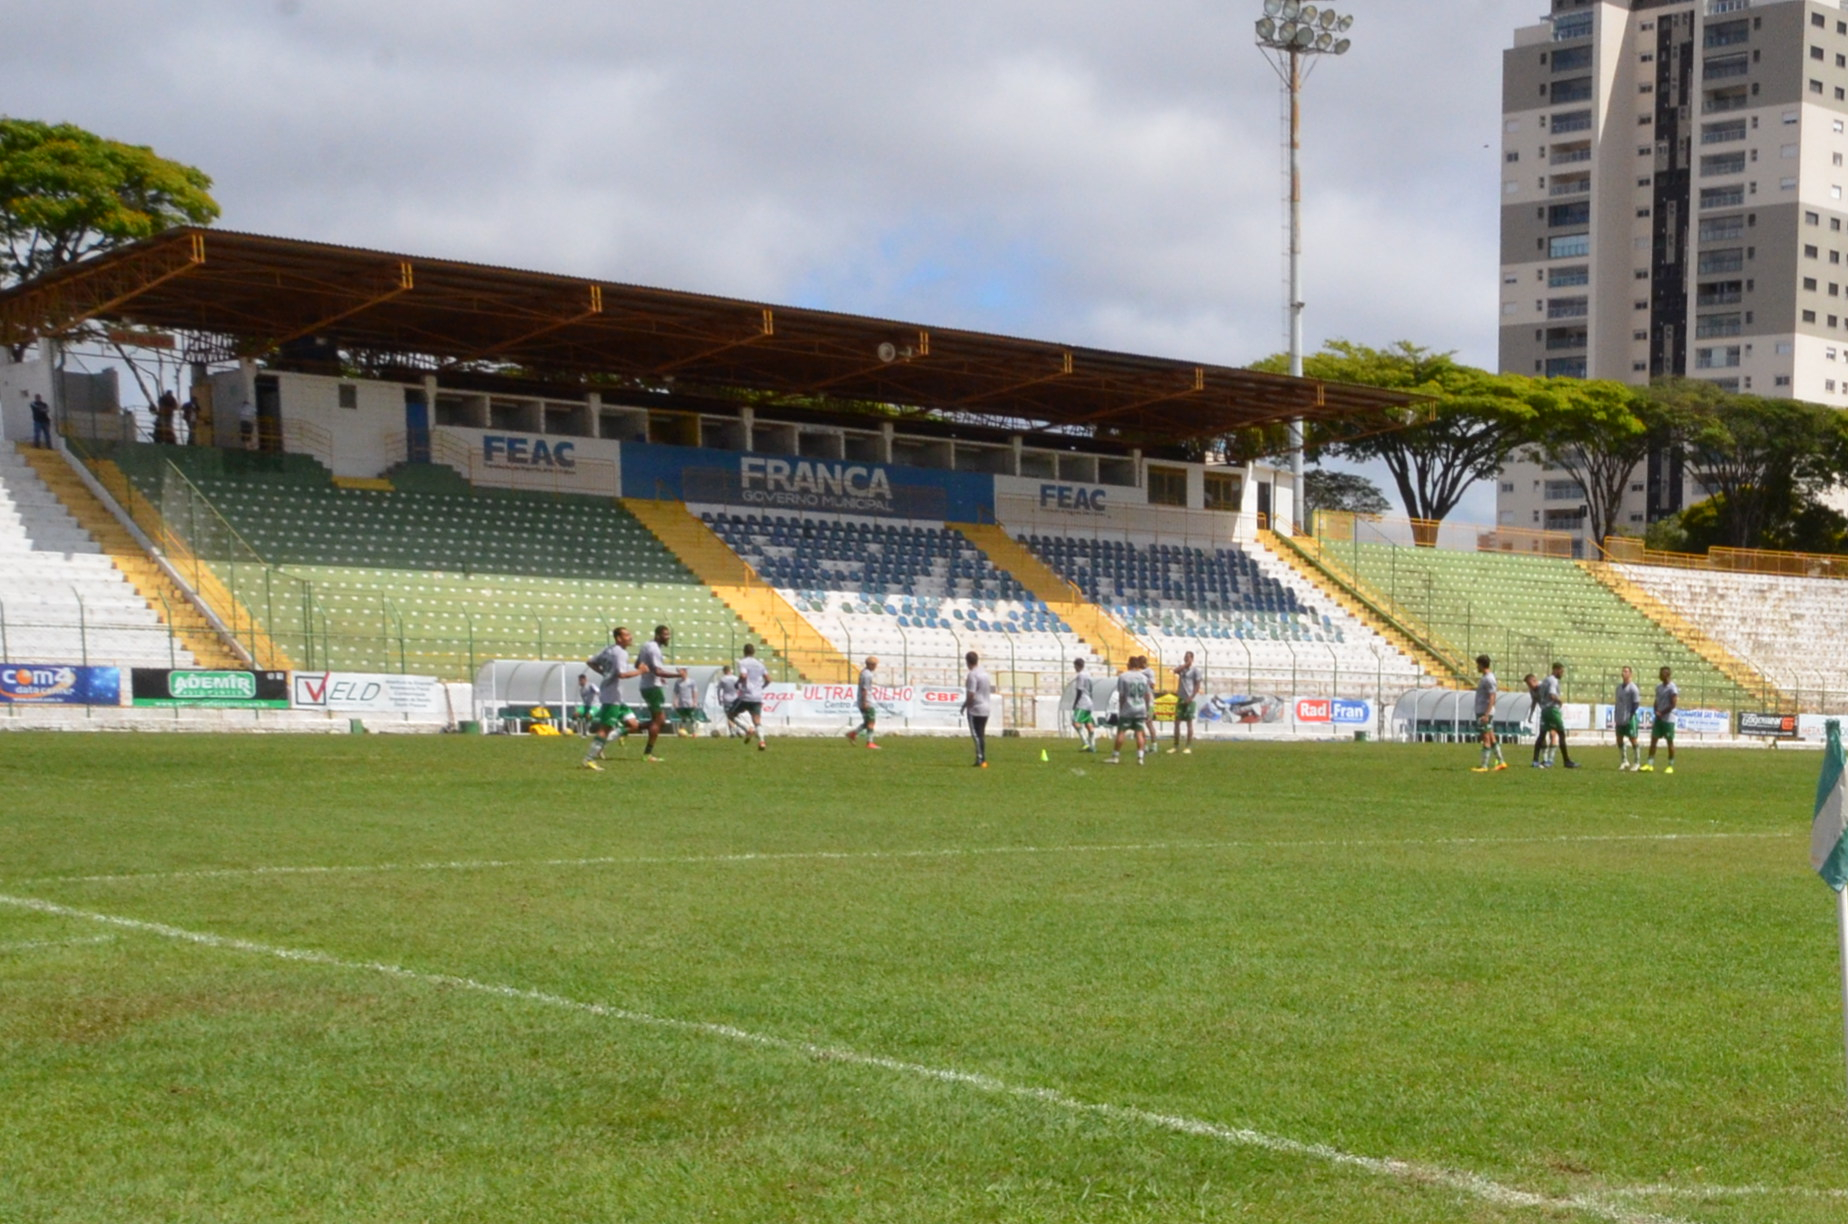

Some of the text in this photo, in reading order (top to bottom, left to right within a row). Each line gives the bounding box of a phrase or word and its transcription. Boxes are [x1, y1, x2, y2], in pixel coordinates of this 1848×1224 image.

[483, 435, 576, 467] FEAC
[740, 456, 893, 499] FRANCA
[742, 490, 894, 512] GOVERNO MUNICIPAL
[1040, 484, 1106, 511] FEAC
[803, 686, 913, 702] ULTRA RILHO
[924, 692, 961, 702] CBF
